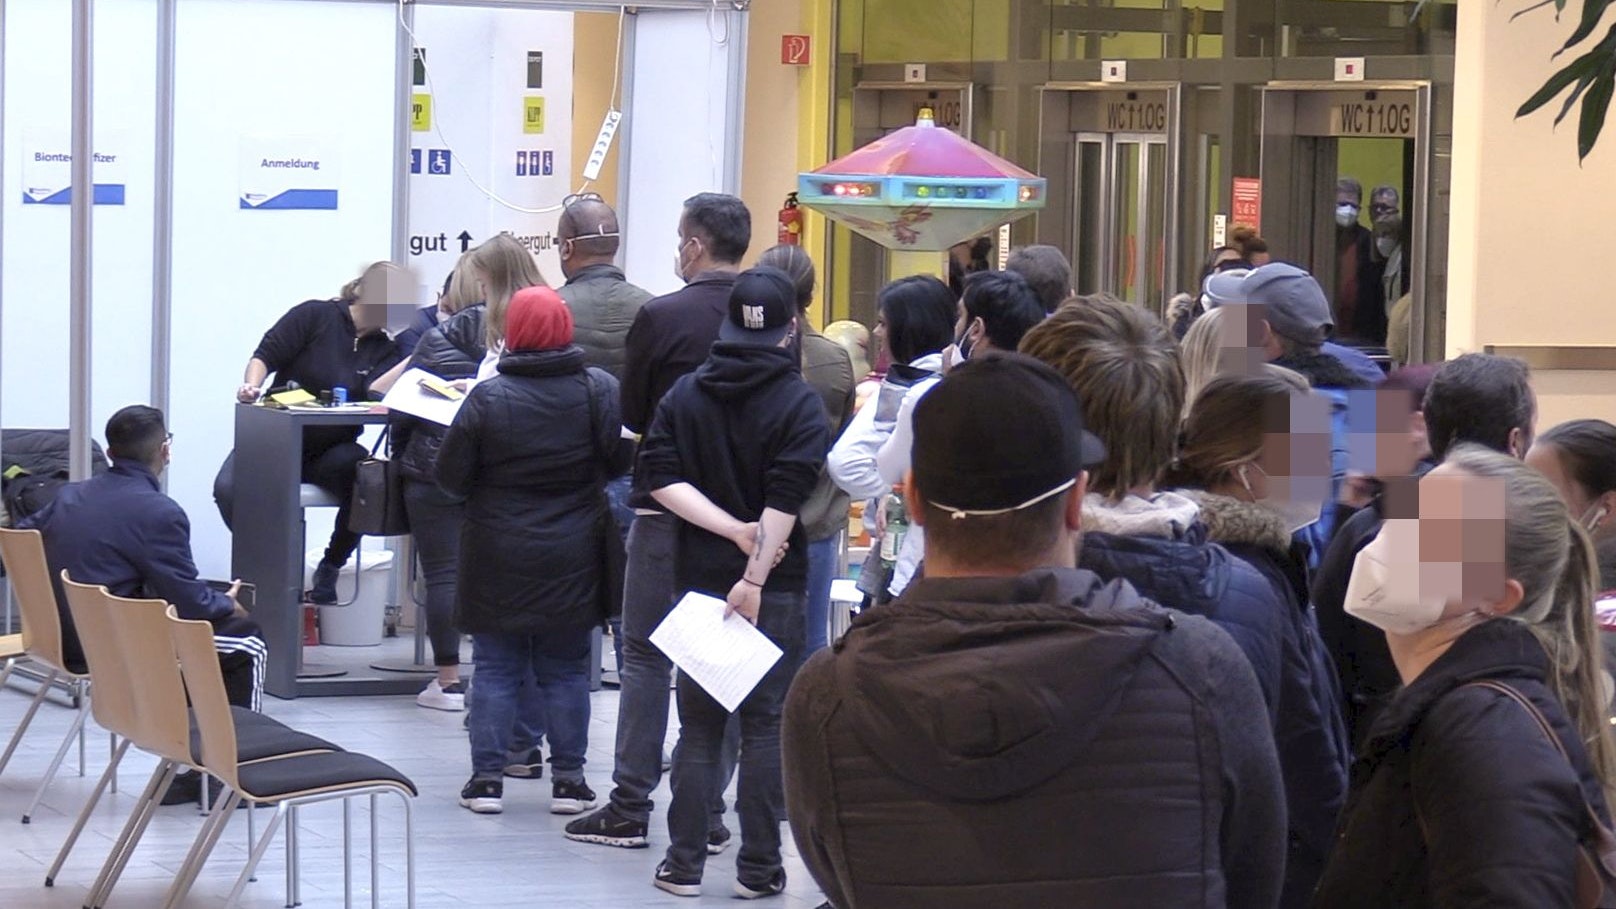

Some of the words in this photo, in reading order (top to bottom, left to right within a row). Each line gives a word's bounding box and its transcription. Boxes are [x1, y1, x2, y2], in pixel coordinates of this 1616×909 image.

[1108, 103, 1125, 130] WC
[1341, 104, 1363, 133] WC
[1378, 104, 1410, 134] 1.OG
[92, 153, 116, 162] fizer
[261, 158, 320, 171] Anmeldung
